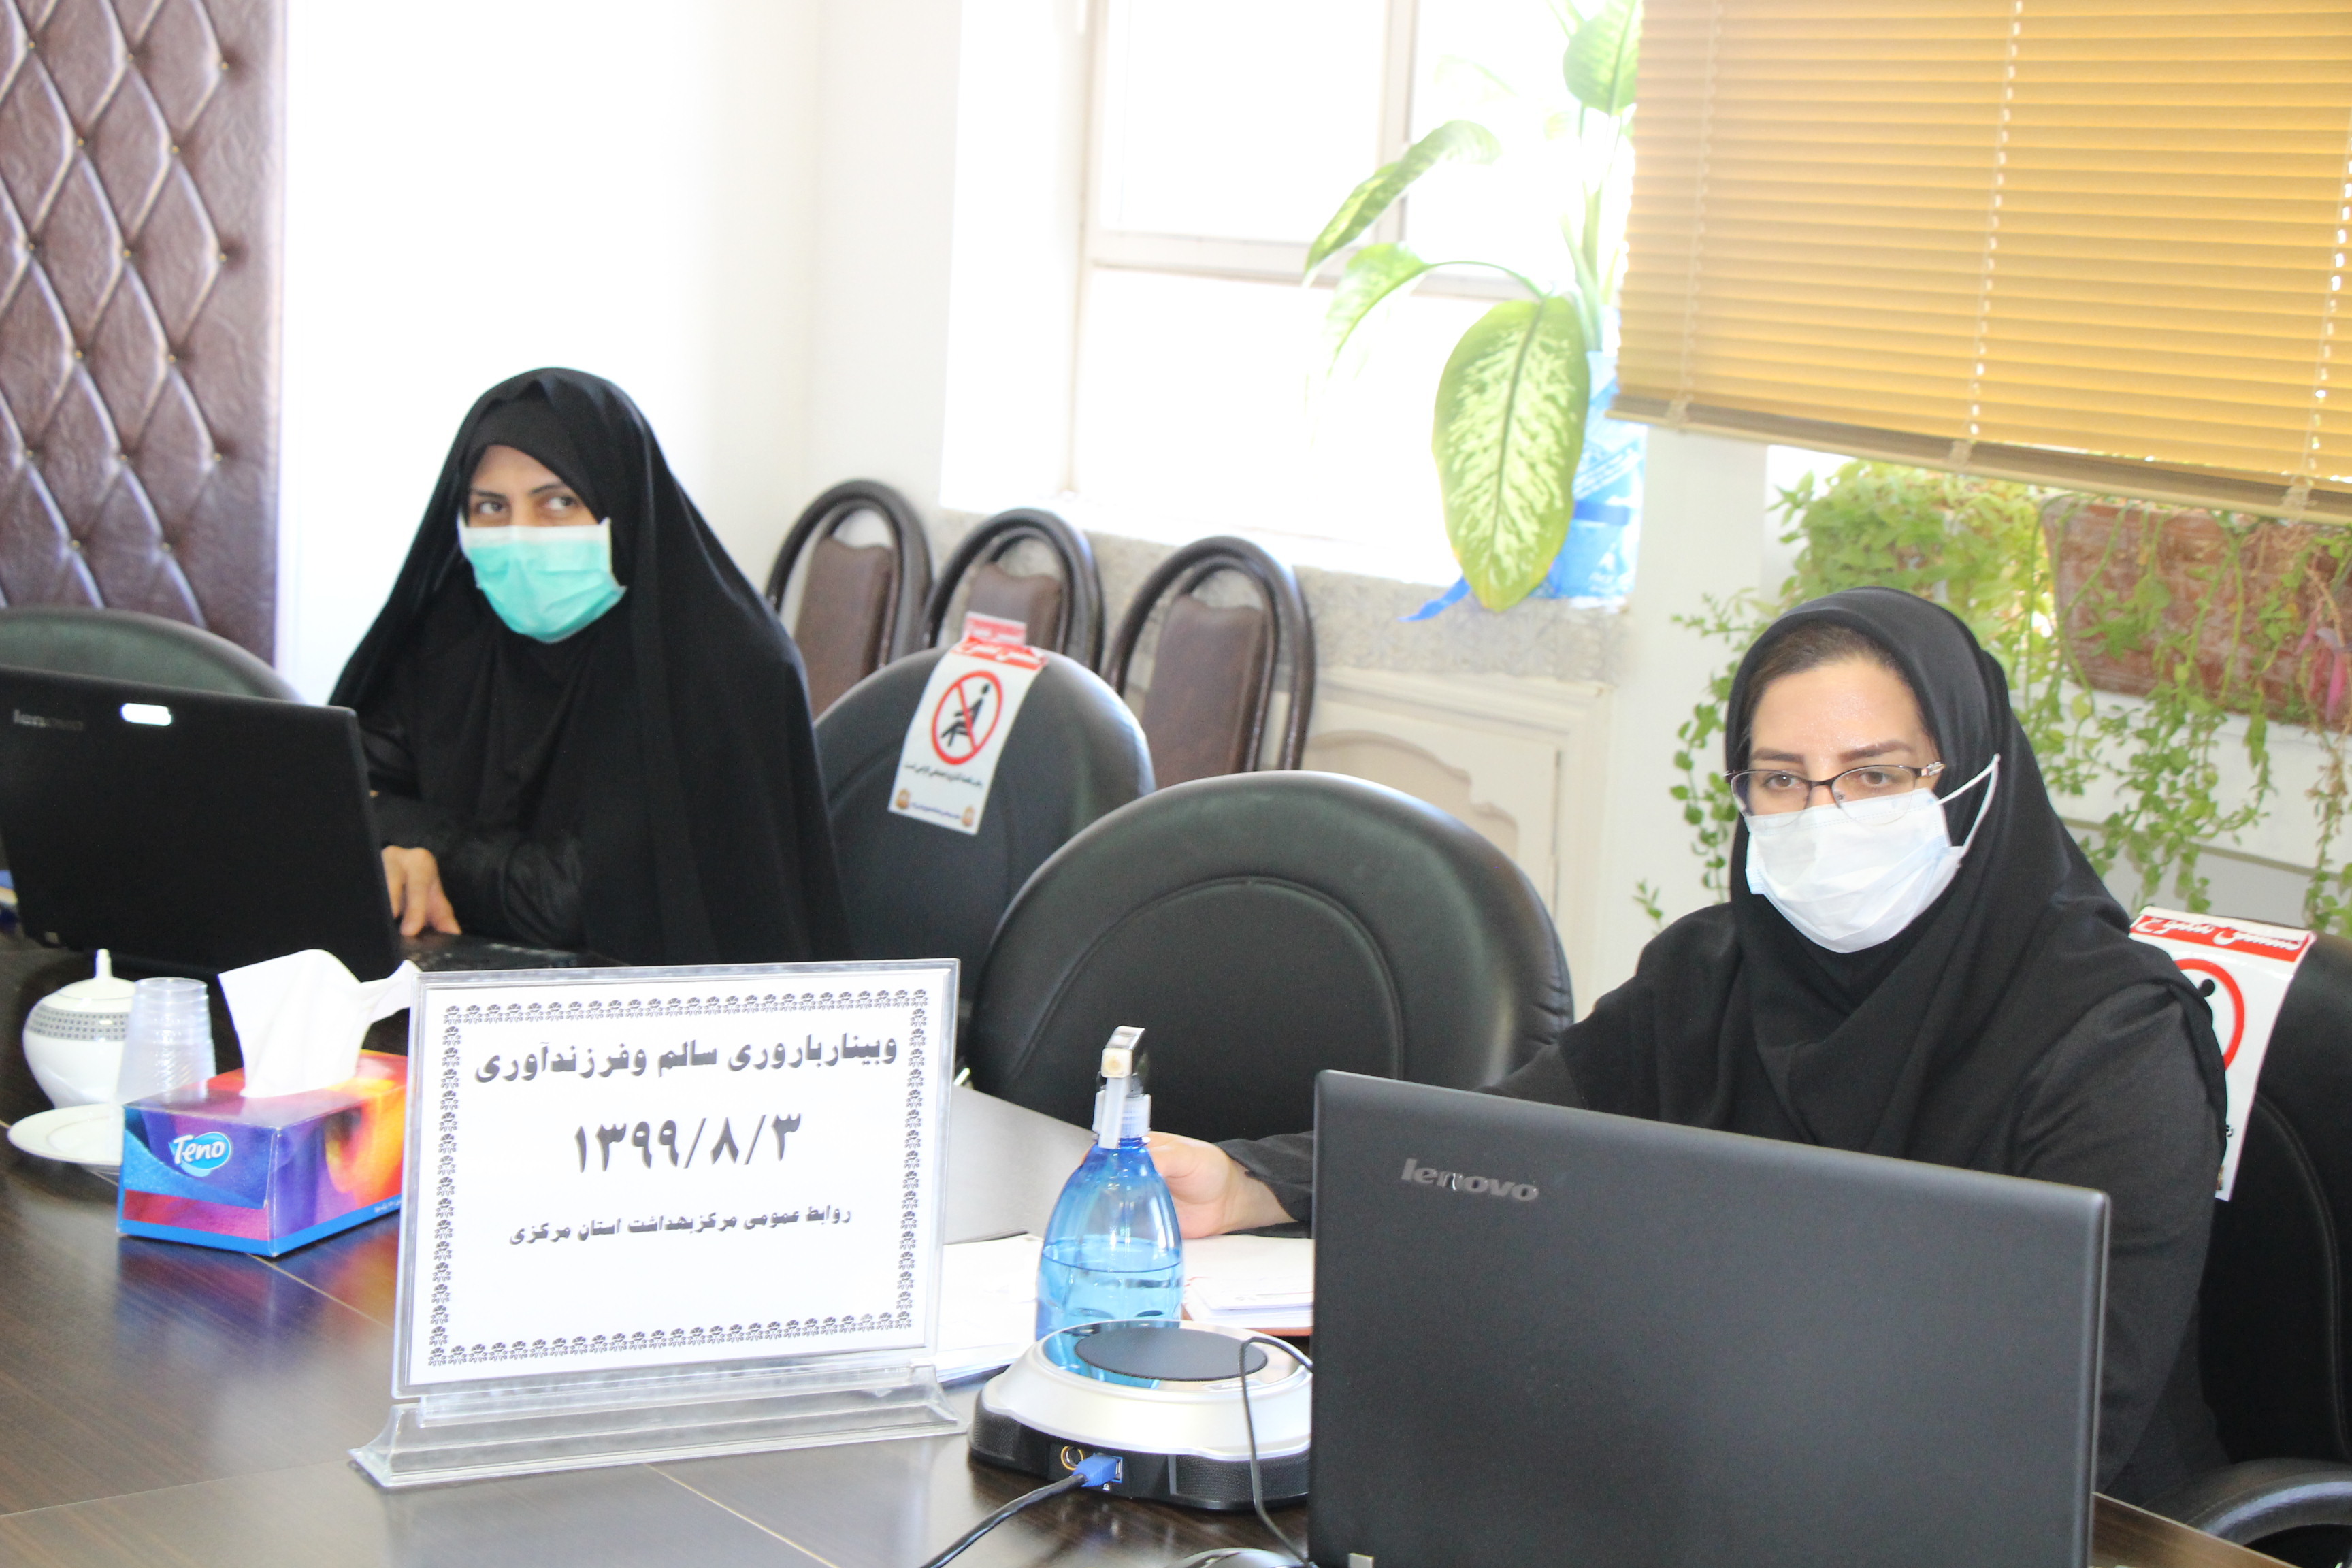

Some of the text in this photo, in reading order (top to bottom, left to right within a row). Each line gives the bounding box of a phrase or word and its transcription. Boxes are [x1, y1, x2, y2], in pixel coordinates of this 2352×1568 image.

[657, 1039, 718, 1078] سالم
[173, 1134, 226, 1165] Teno
[1401, 1158, 1539, 1200] lenovo
[743, 1210, 800, 1231] عمومی
[805, 1204, 852, 1226] روابط
[509, 1222, 572, 1246] مرکزی
[577, 1217, 622, 1243] استان
